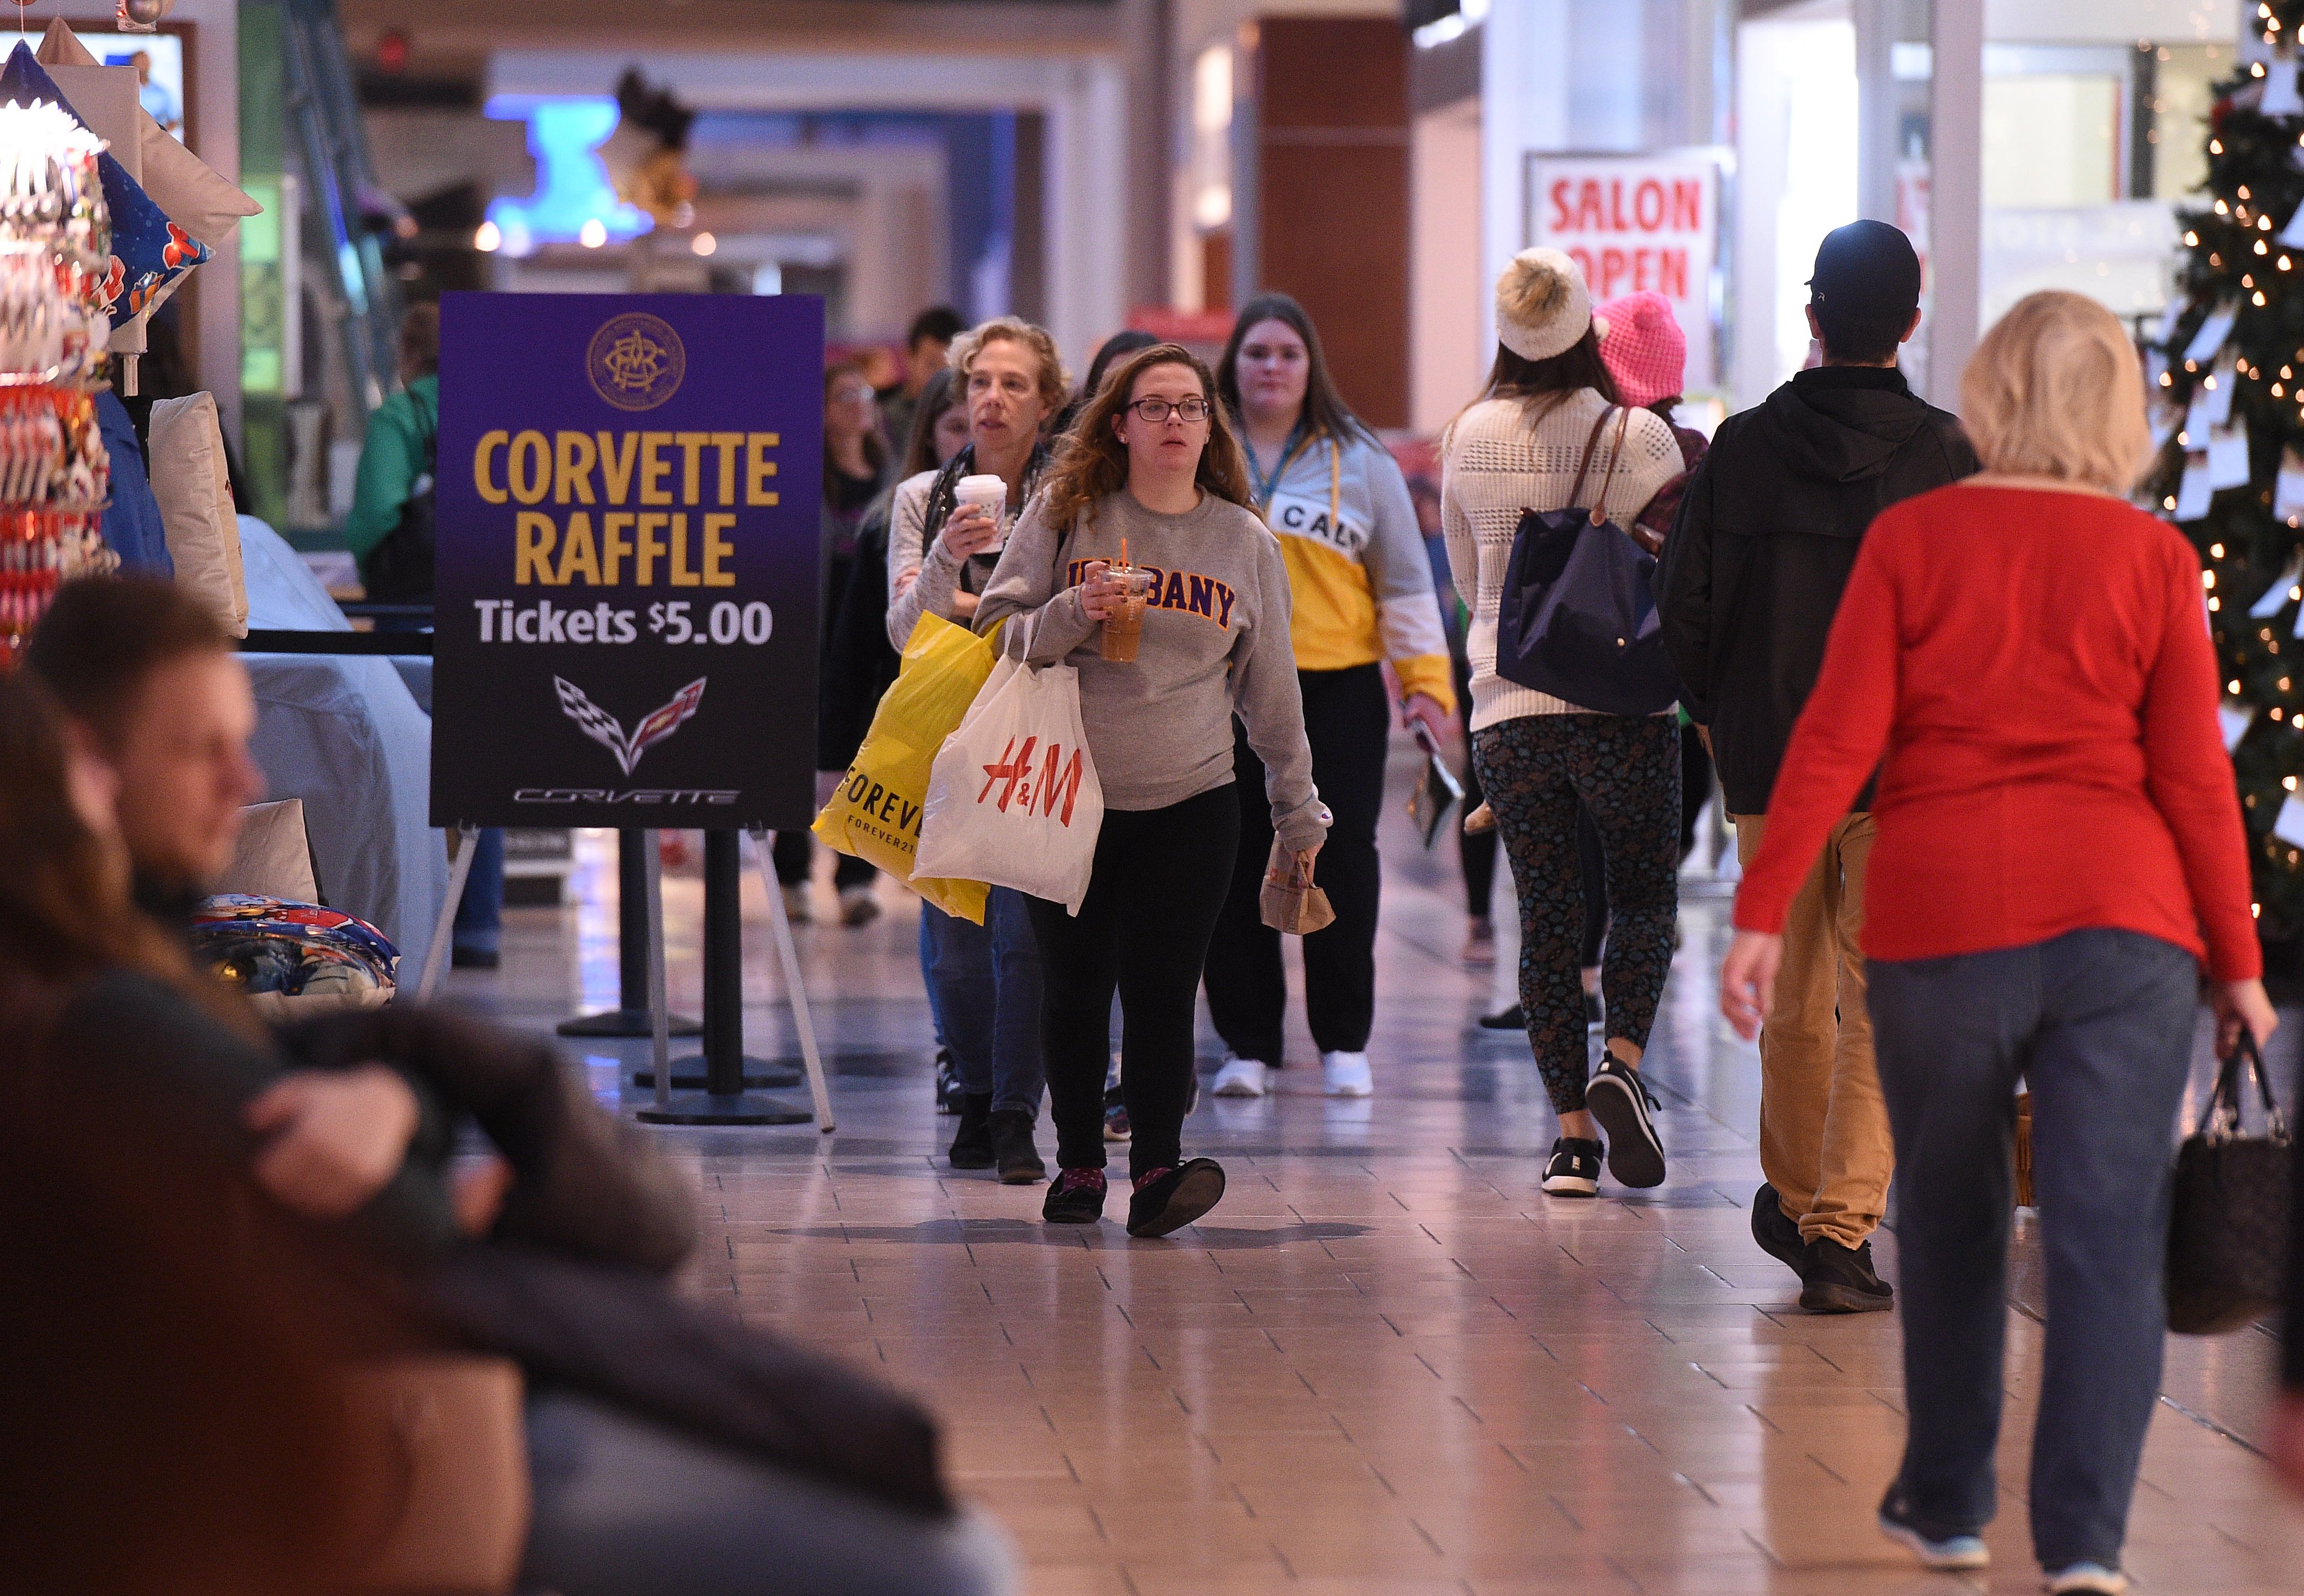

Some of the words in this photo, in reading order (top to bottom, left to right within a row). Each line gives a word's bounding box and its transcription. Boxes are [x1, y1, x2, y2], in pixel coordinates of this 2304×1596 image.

[1550, 179, 1701, 233] SALON
[1568, 246, 1688, 301] OPEN
[474, 430, 780, 506] CORVETTE
[515, 511, 737, 587] RAFFLE
[474, 599, 637, 643] Tickets
[649, 600, 773, 644] $5.00
[513, 788, 741, 804] CORVETTE
[978, 735, 1083, 828] H&M
